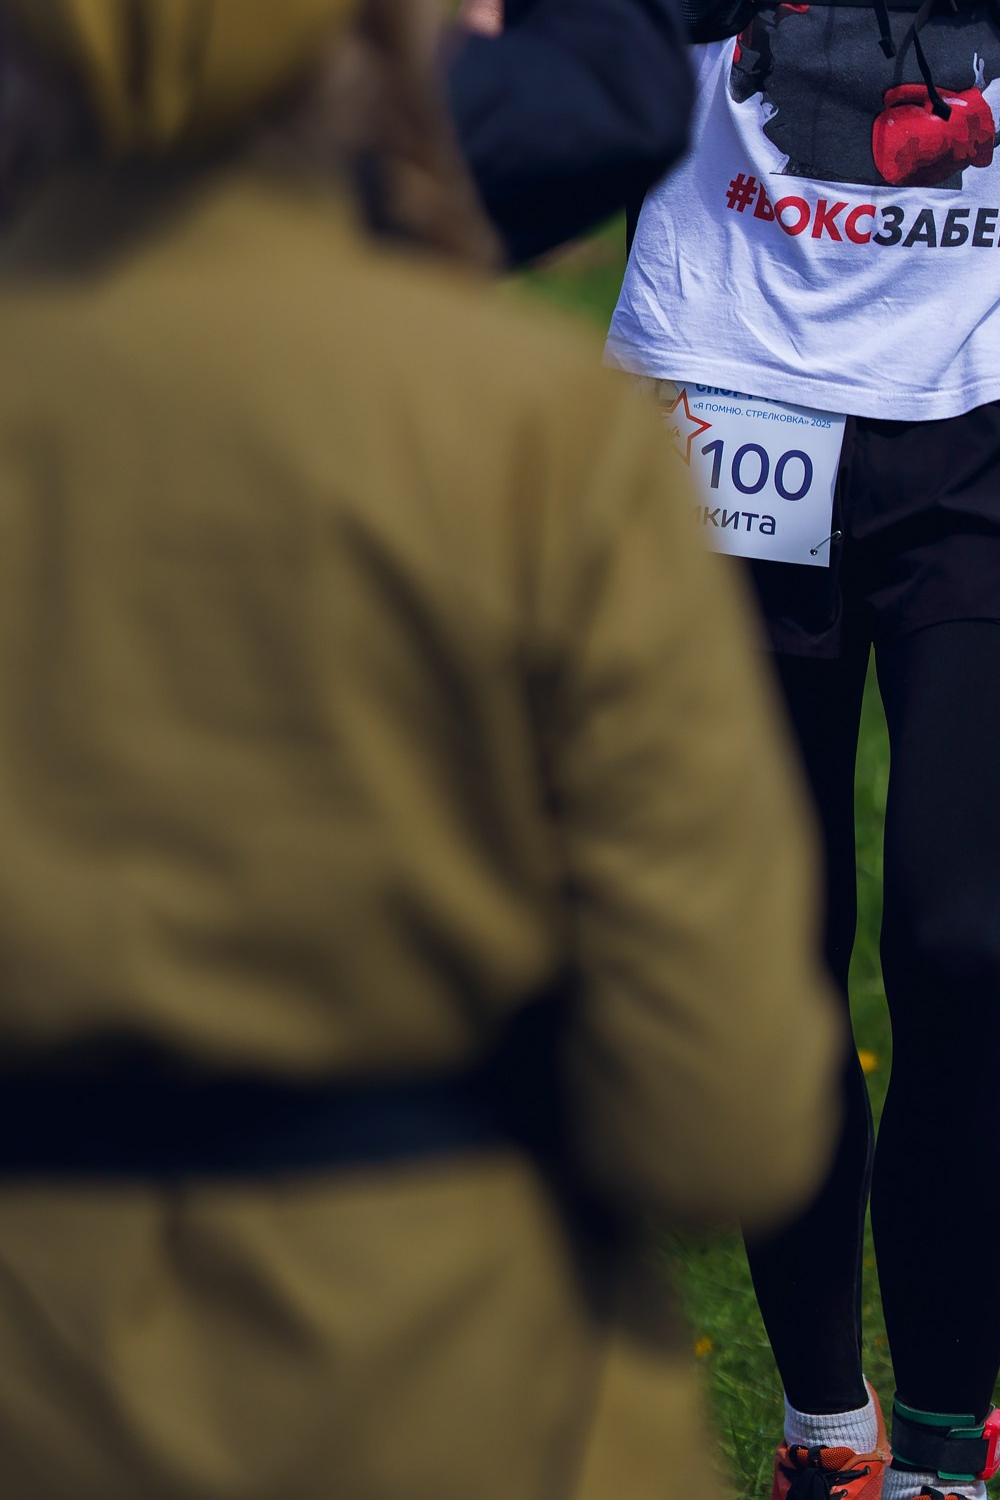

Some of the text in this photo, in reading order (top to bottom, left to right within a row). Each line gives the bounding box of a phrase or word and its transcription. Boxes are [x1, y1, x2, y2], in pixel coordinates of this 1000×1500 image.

[705, 403, 744, 416] ПОМНЮ.
[745, 409, 809, 425] СТРЕЛКОВКА»
[810, 419, 832, 429] 2025
[701, 439, 813, 501] 100
